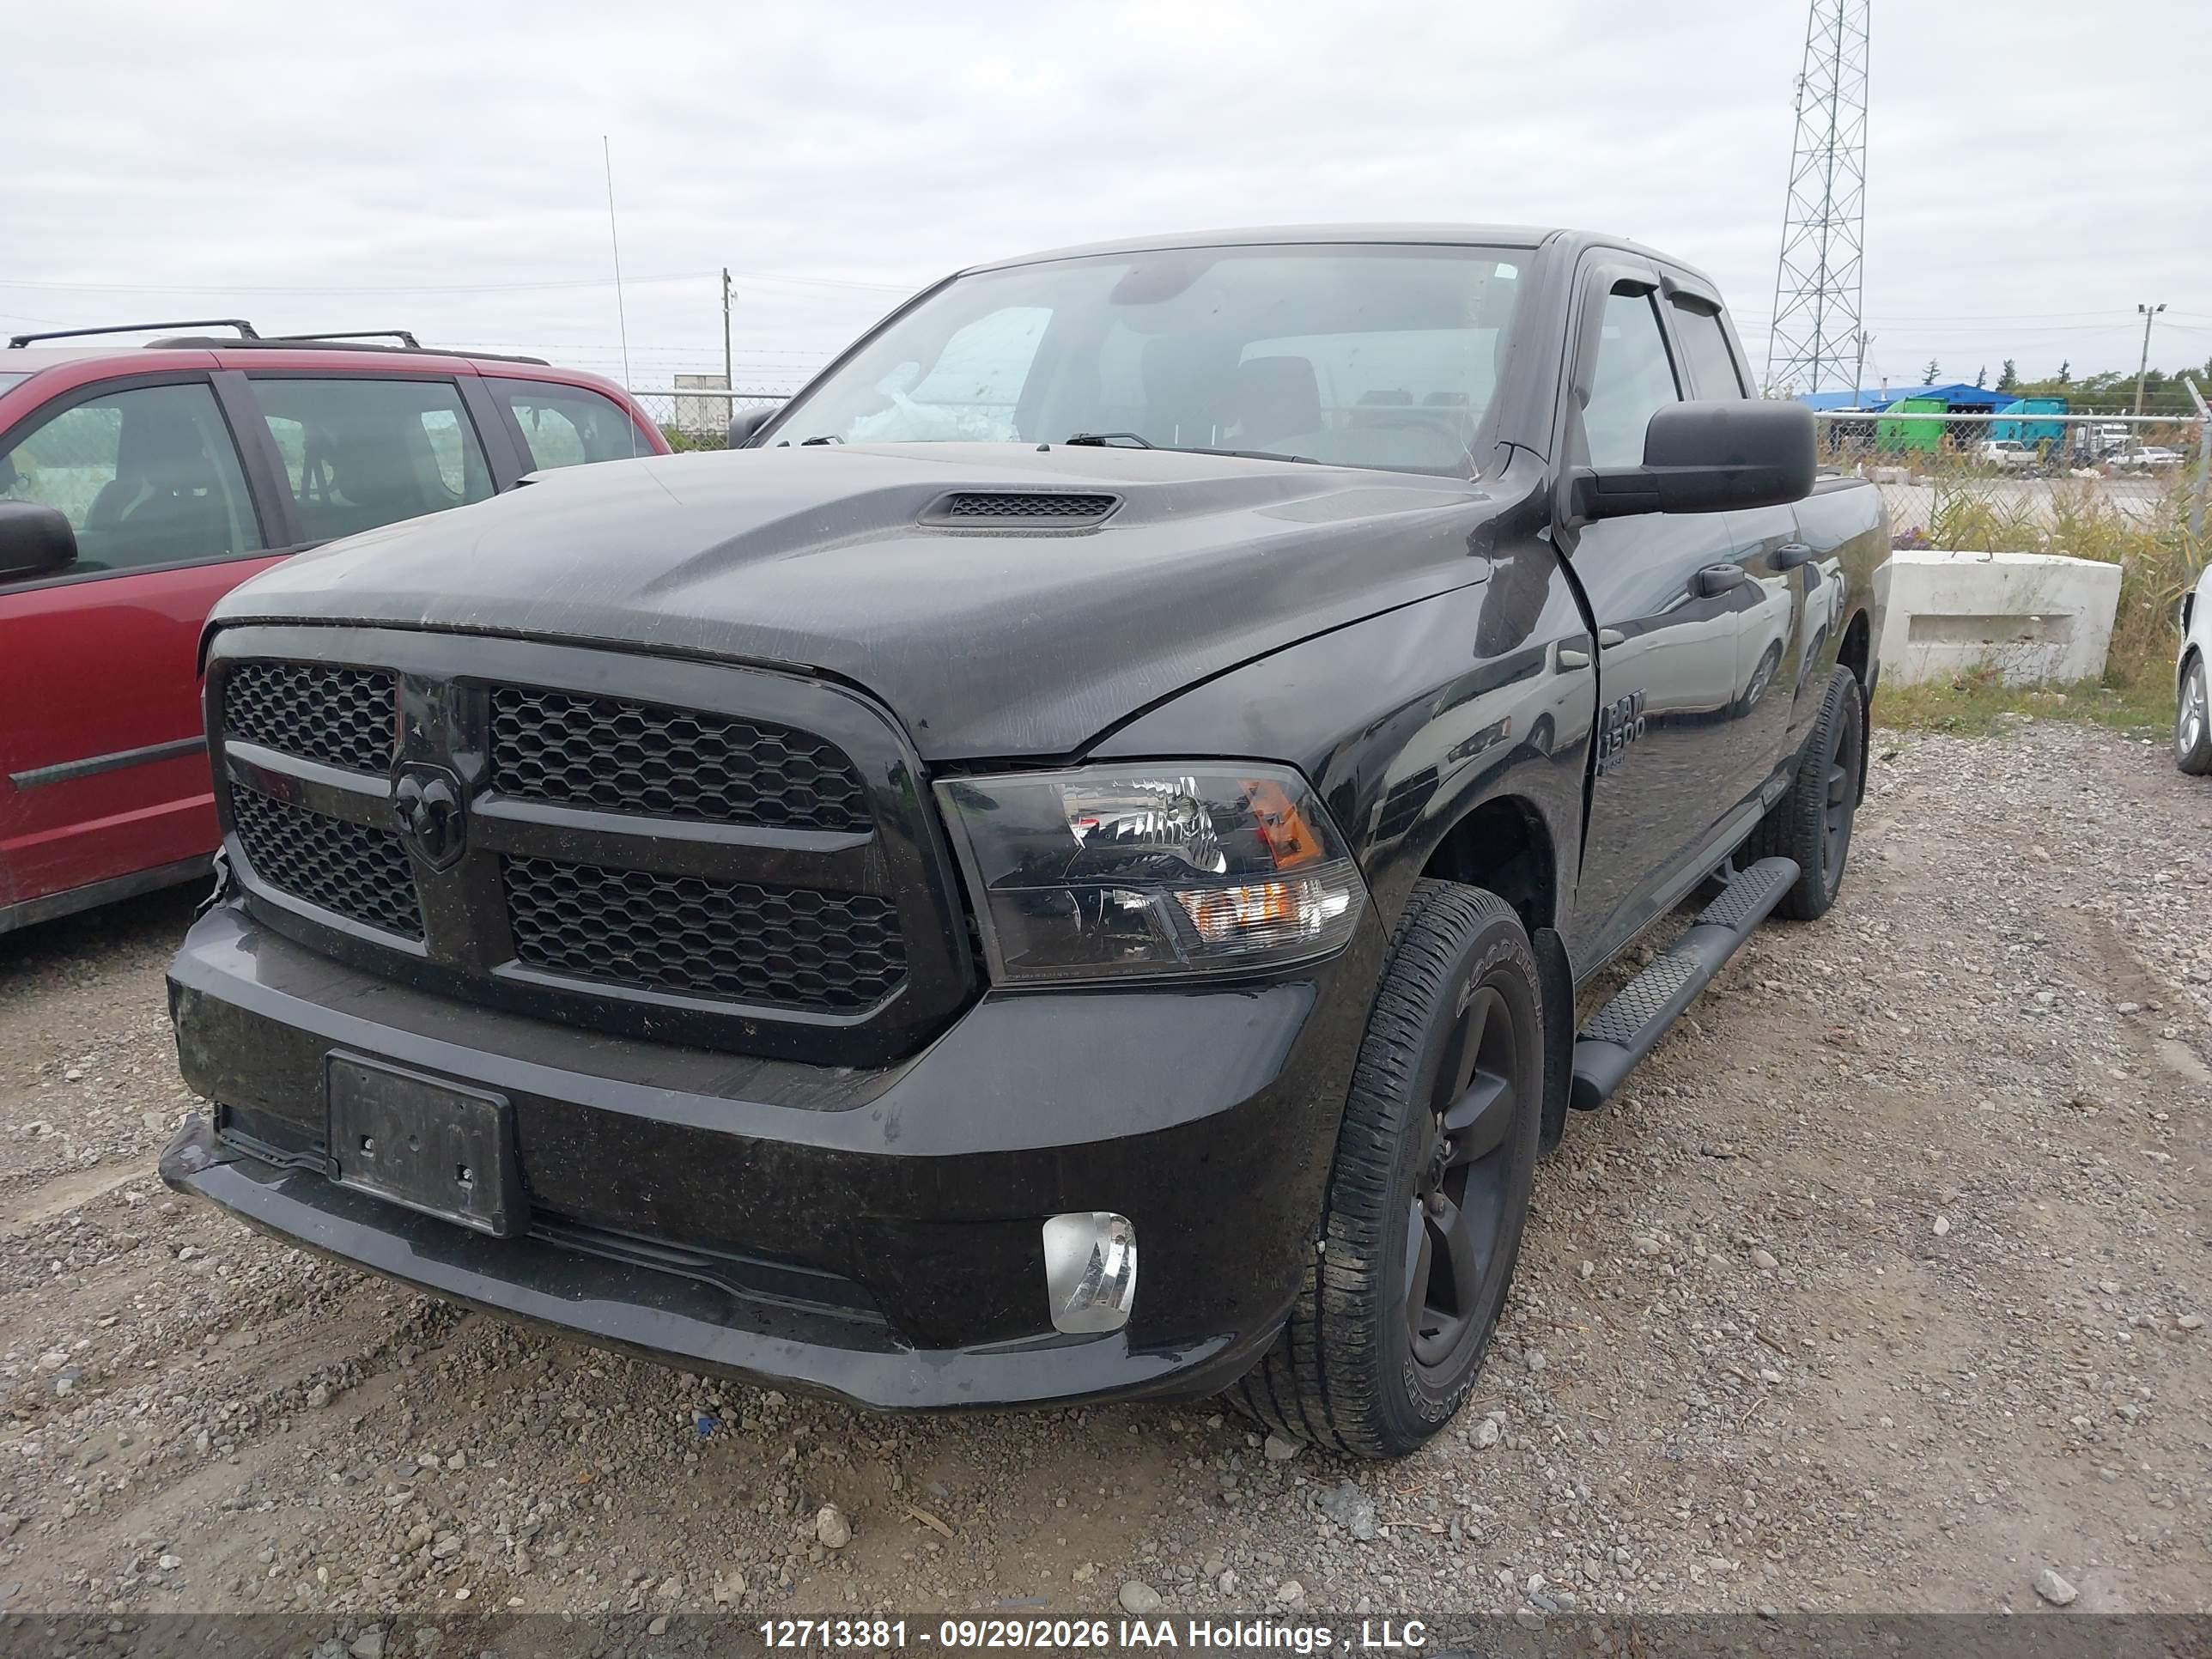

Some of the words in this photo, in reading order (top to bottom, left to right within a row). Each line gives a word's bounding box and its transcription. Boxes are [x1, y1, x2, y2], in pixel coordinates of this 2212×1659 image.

[1600, 688, 1648, 732] RAM
[1599, 716, 1646, 759] 1500
[1455, 939, 1544, 1032] GOODYEAR
